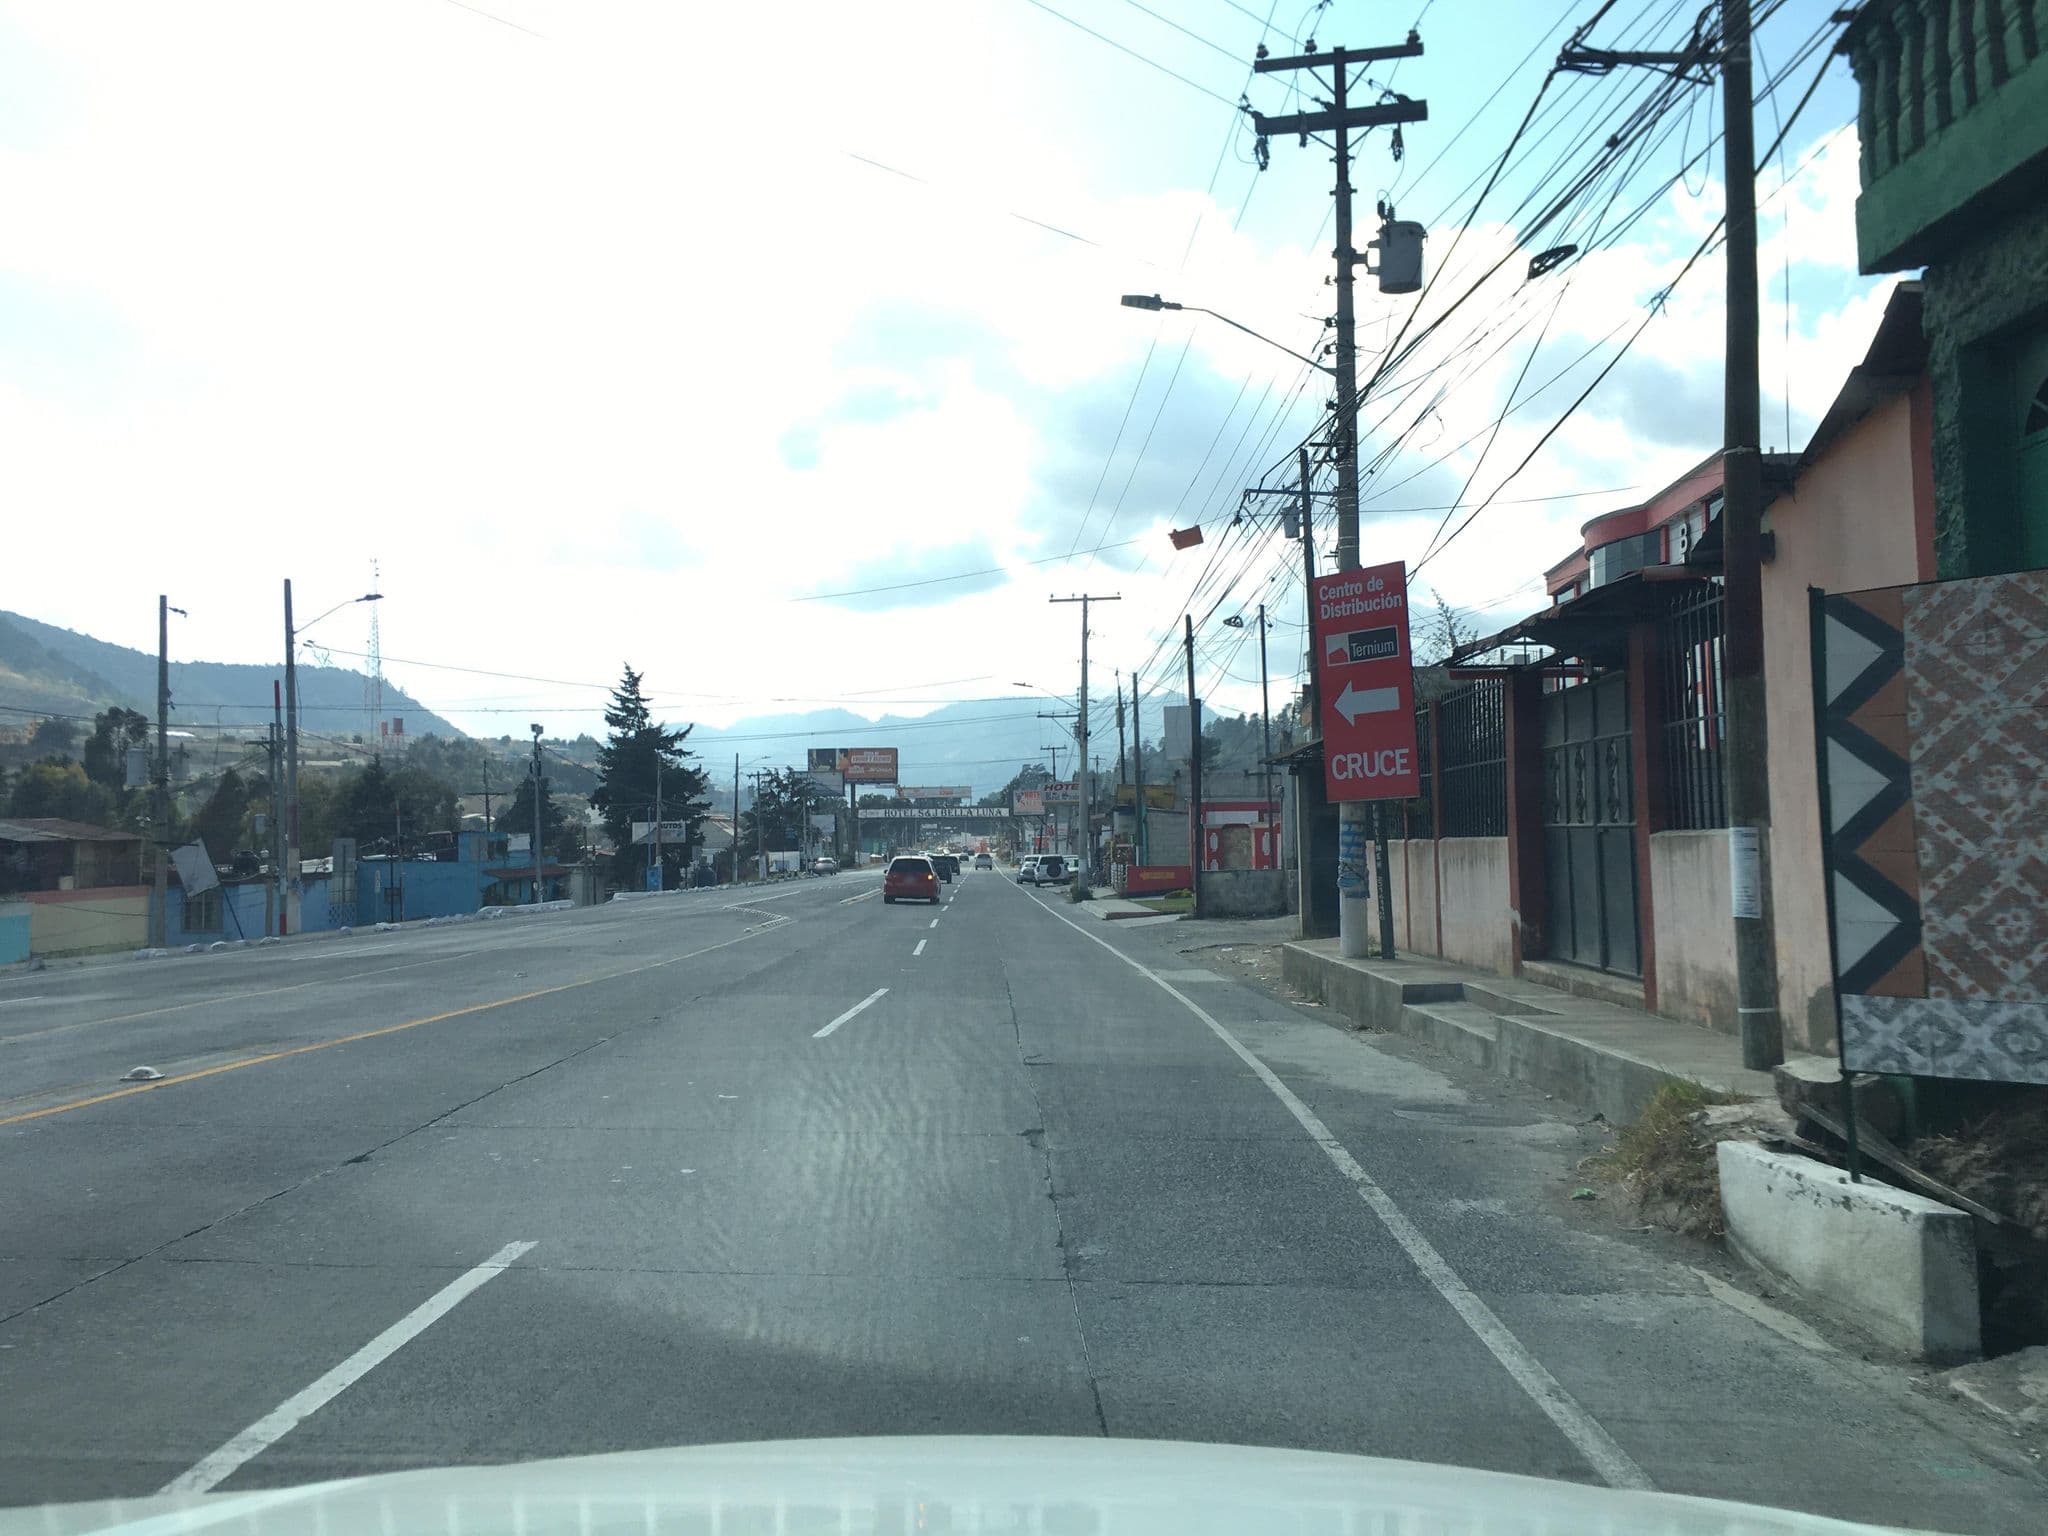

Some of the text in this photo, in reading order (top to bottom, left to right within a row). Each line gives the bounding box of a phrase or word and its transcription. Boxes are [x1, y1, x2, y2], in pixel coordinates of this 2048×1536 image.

[1319, 576, 1385, 601] Centro de
[1320, 592, 1402, 620] Distribución
[1350, 640, 1395, 658] Ternium
[1331, 748, 1411, 780] CRUCE
[884, 808, 917, 817] HOTEL
[941, 808, 974, 817] BELLA
[975, 808, 1002, 817] LUNA
